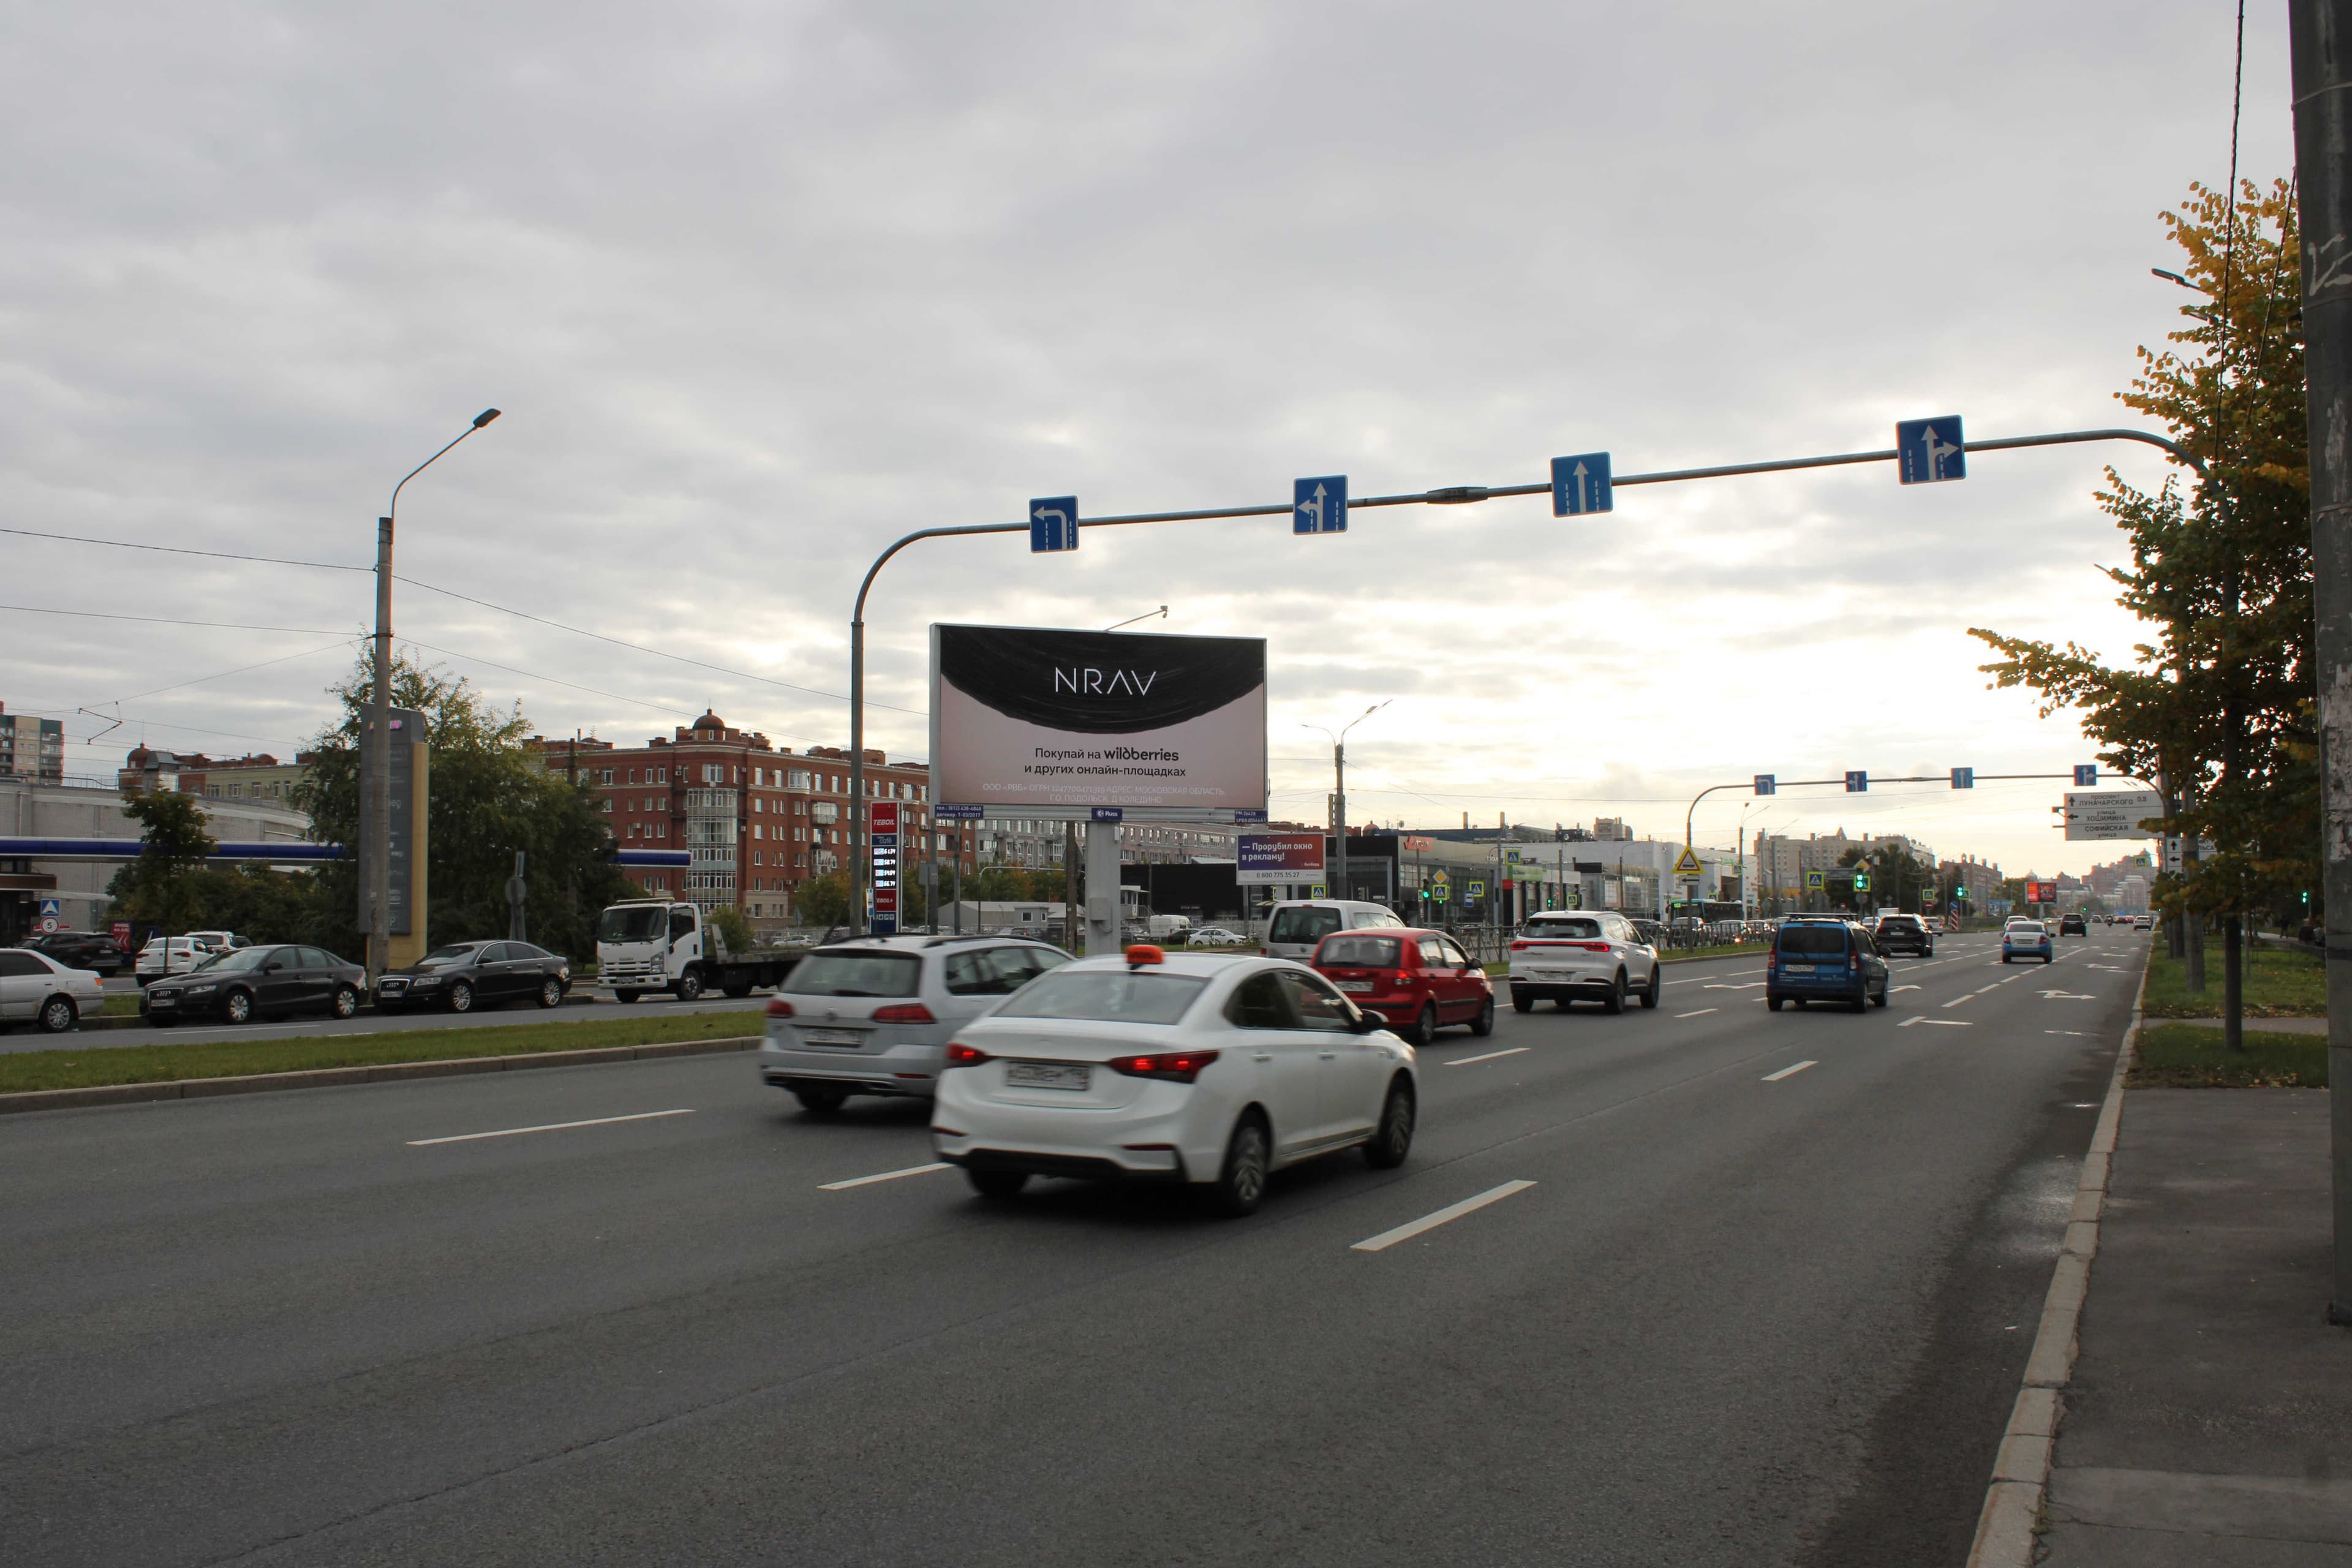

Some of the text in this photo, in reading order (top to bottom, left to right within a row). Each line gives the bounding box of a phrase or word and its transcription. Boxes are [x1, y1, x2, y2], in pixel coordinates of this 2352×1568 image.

[1055, 666, 1156, 696] NRAV
[1035, 747, 1084, 760] Покупай
[1103, 747, 1179, 761] wildberries
[1034, 765, 1074, 775] других
[1077, 765, 1186, 777] онлайн-площадках
[1135, 786, 1187, 795] МОСКОВСКАЯ
[1252, 842, 1292, 852] Прорубил
[1248, 853, 1285, 862] рекламу!
